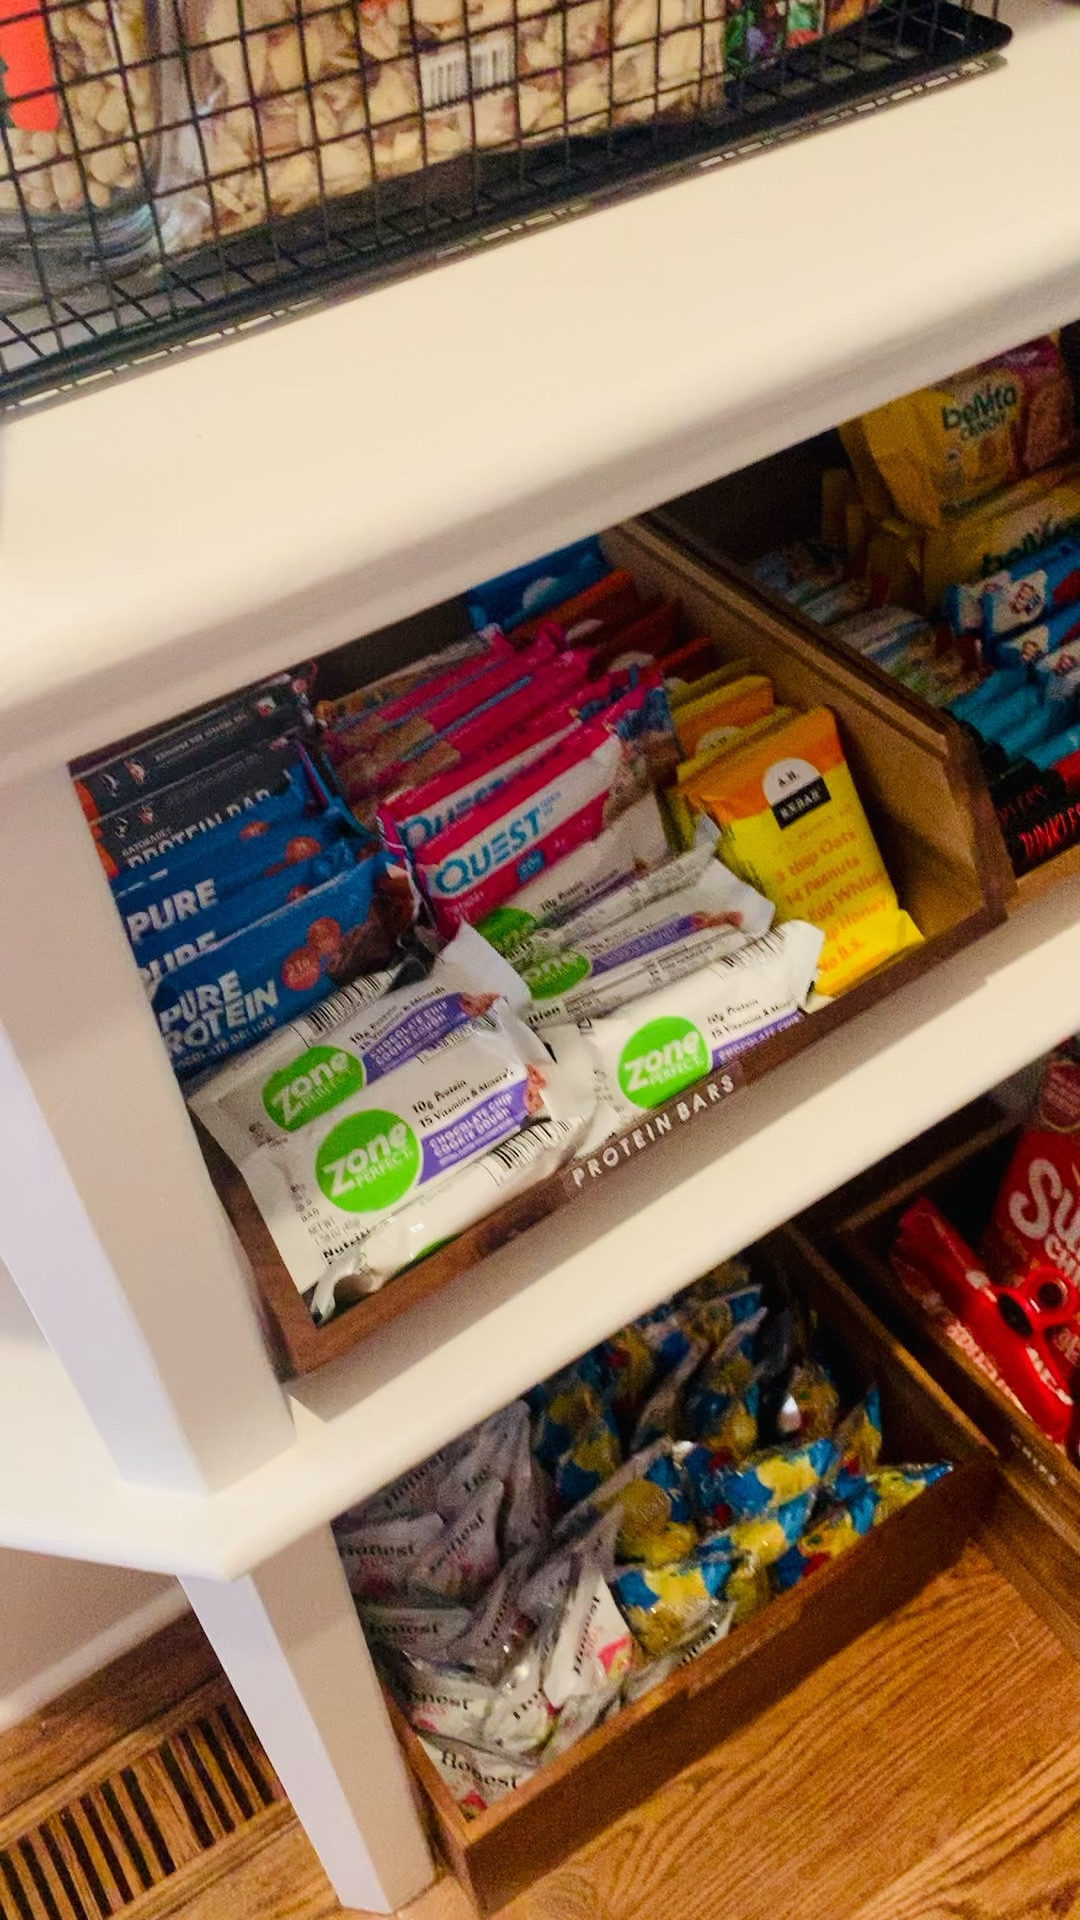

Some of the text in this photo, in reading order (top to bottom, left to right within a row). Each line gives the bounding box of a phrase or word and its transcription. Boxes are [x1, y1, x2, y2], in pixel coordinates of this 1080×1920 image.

[435, 806, 541, 893] QUEST
[126, 878, 218, 945] PURE
[159, 968, 243, 1034] PURE
[163, 980, 280, 1058] ROTEIN
[272, 1051, 351, 1126] zone
[623, 1030, 700, 1093] zone
[411, 1079, 467, 1114] 10g Protein
[419, 1117, 433, 1129] 15
[428, 1107, 490, 1149] CHOCOLATE
[487, 1091, 513, 1112] CHIP
[322, 1121, 408, 1198] zone
[433, 1129, 476, 1158] COOKIE
[474, 1106, 512, 1136] DOUGH
[572, 1113, 673, 1188] PROTEIN
[676, 1074, 735, 1123] BARS
[440, 1748, 519, 1790] Honest
